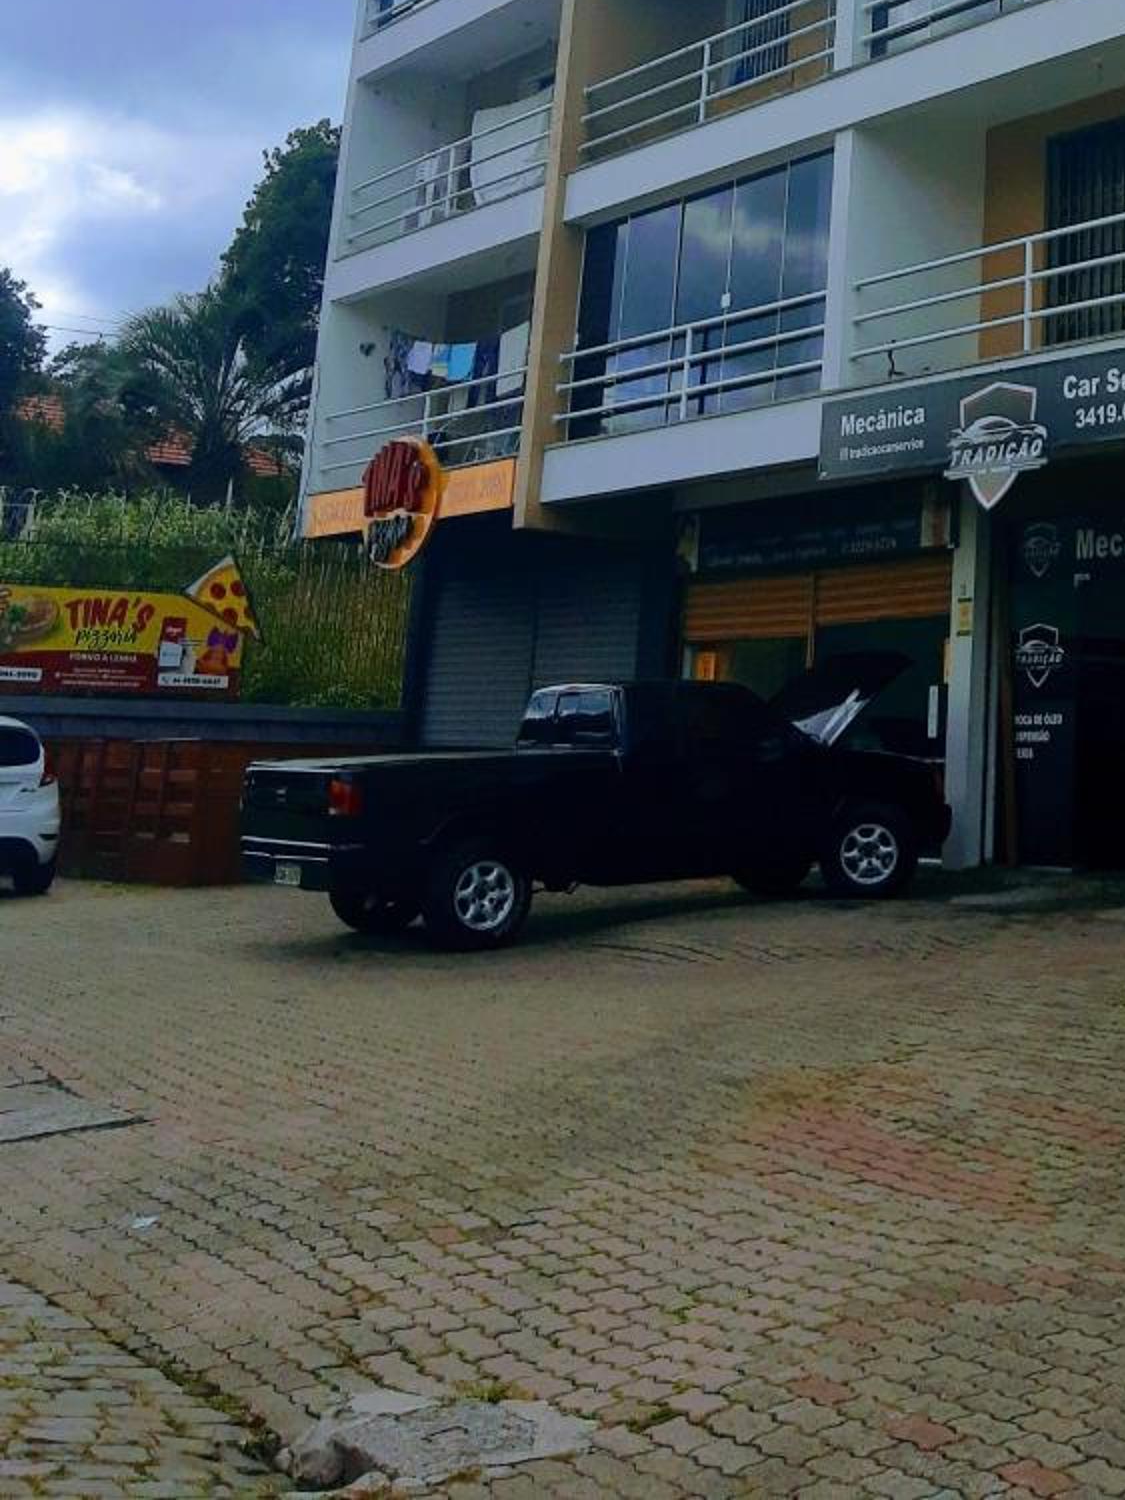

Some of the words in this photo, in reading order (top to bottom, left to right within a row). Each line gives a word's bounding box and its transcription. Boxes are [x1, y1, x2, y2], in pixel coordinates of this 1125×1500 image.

[1062, 374, 1101, 400] Car
[840, 404, 926, 437] Mecânica
[951, 439, 1044, 468] TRADIÇÃO
[65, 598, 156, 633] TINA'S
